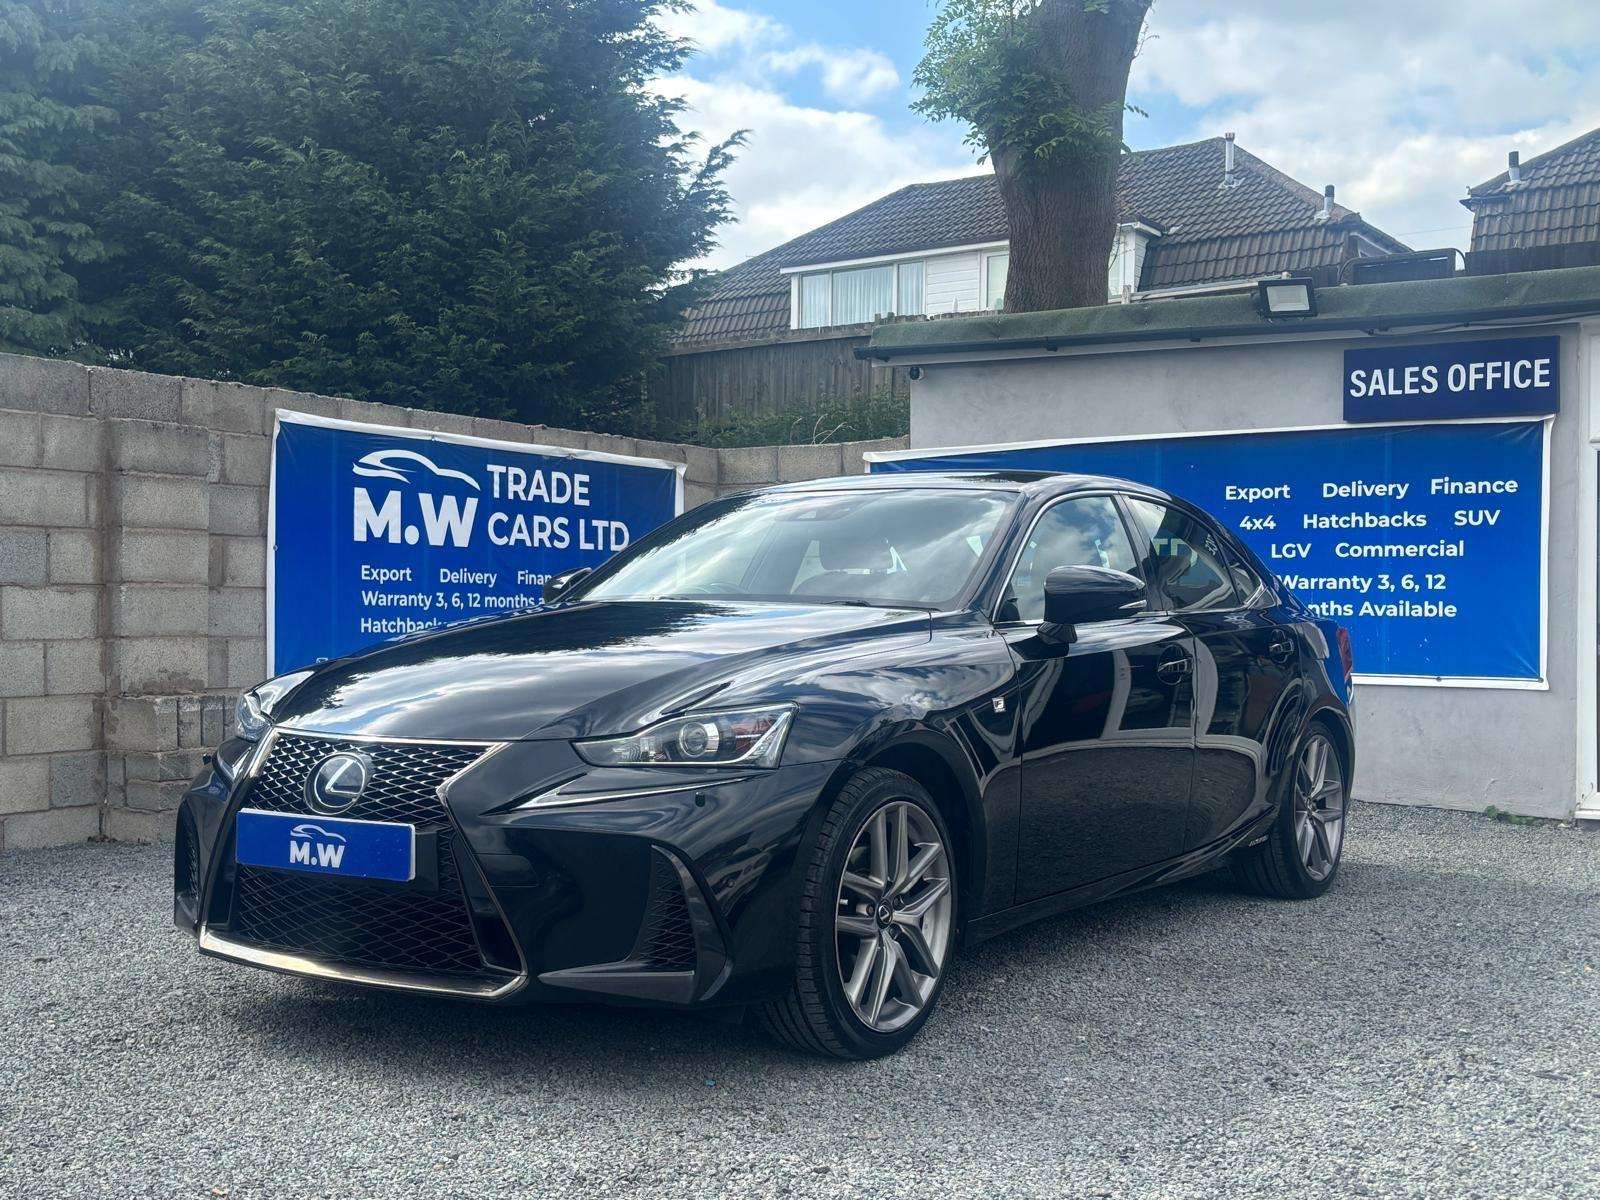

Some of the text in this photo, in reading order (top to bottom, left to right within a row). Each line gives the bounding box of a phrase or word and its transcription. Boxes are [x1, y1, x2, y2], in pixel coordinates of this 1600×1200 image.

[1349, 358, 1551, 398] SALES OFFICE
[486, 464, 590, 507] TRADE
[1225, 476, 1519, 503] Export Delivery Finance
[353, 486, 479, 548] M.W
[1239, 509, 1501, 530] 4x4 Hatchbacks SUV
[487, 511, 631, 552] CARS LTD
[1271, 539, 1464, 559] LGV Commercial
[361, 564, 412, 584] Export
[440, 568, 498, 588] Delivery
[1276, 574, 1446, 594] Warranty 3, 6, 12
[361, 590, 433, 611] Warranty
[436, 592, 448, 610] 3,
[451, 592, 464, 610] 6,
[467, 593, 481, 608] 12
[484, 593, 535, 609] months
[1307, 600, 1457, 618] nths Available
[289, 840, 345, 868] M.W
